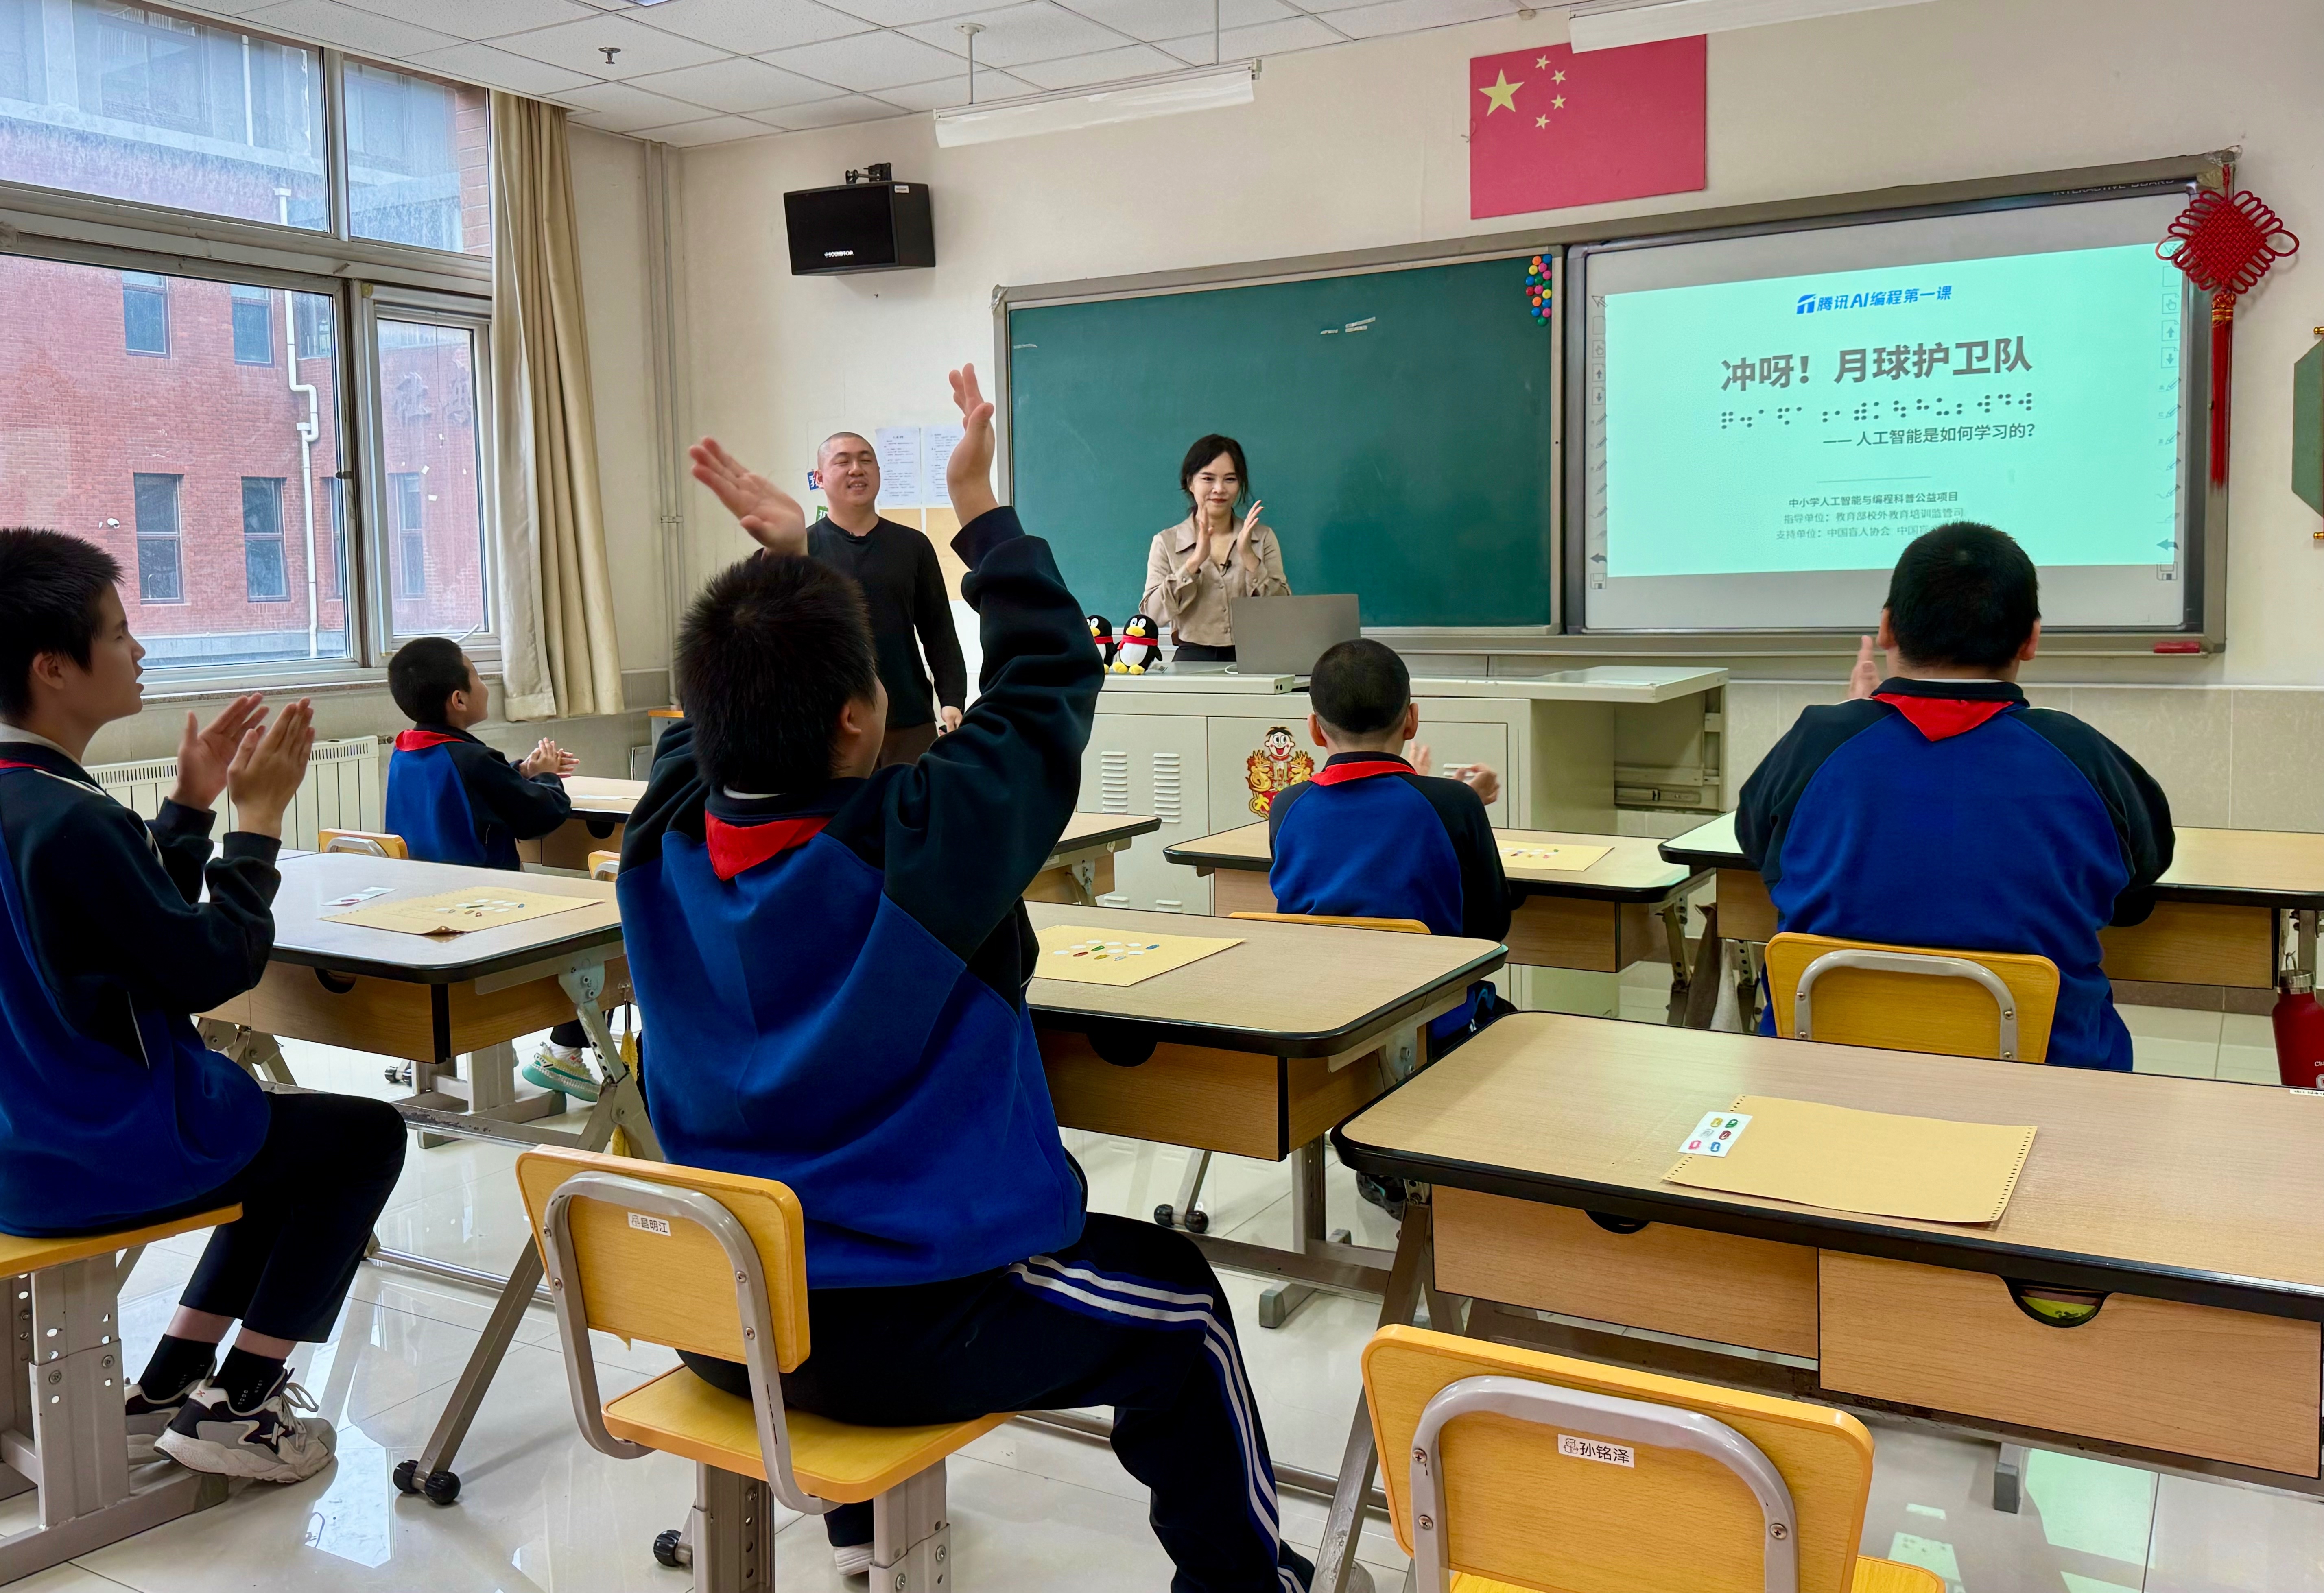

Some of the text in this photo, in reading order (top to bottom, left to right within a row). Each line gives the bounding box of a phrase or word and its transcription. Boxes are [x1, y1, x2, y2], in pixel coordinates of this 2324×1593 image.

[1817, 286, 1952, 312] 腾讯AI编程第一课
[1789, 492, 1957, 507] 中小学人工智能与编程科普公益项目
[1580, 1442, 1629, 1463] 孙铭泽
